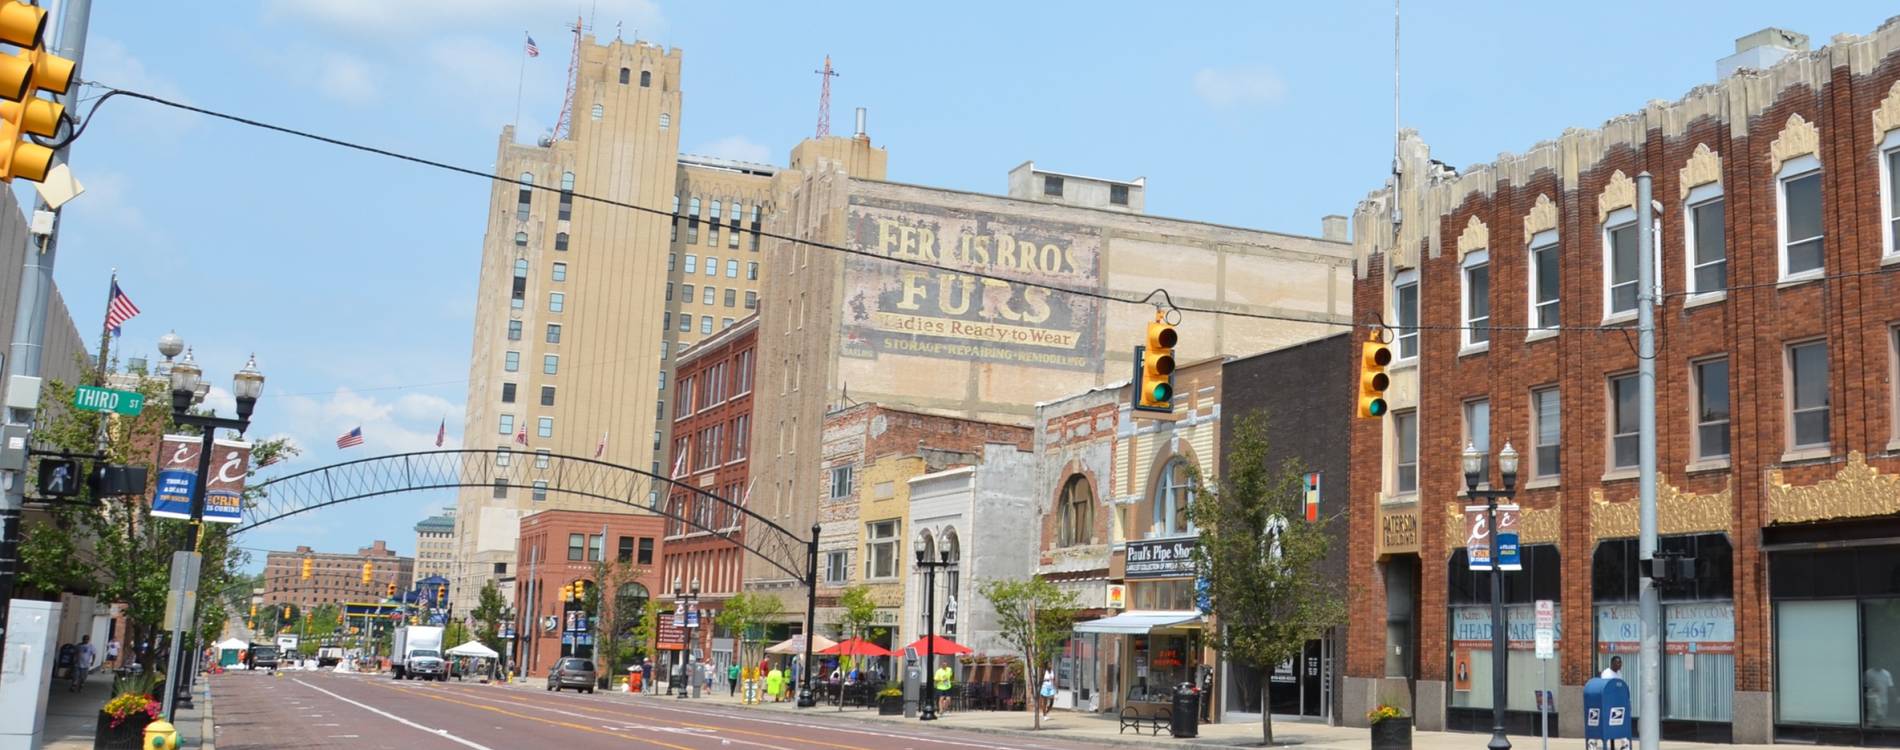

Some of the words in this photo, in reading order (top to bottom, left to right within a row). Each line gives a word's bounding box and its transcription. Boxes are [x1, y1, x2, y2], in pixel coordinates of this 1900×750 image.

[895, 271, 1052, 324] FURS
[883, 337, 943, 353] STORAGE
[78, 388, 119, 410] THIRD
[129, 399, 140, 409] ST
[212, 495, 241, 507] CRIM
[1383, 513, 1417, 532] PATERSON
[1127, 545, 1151, 561] Paul's
[1153, 545, 1171, 562] Pipe
